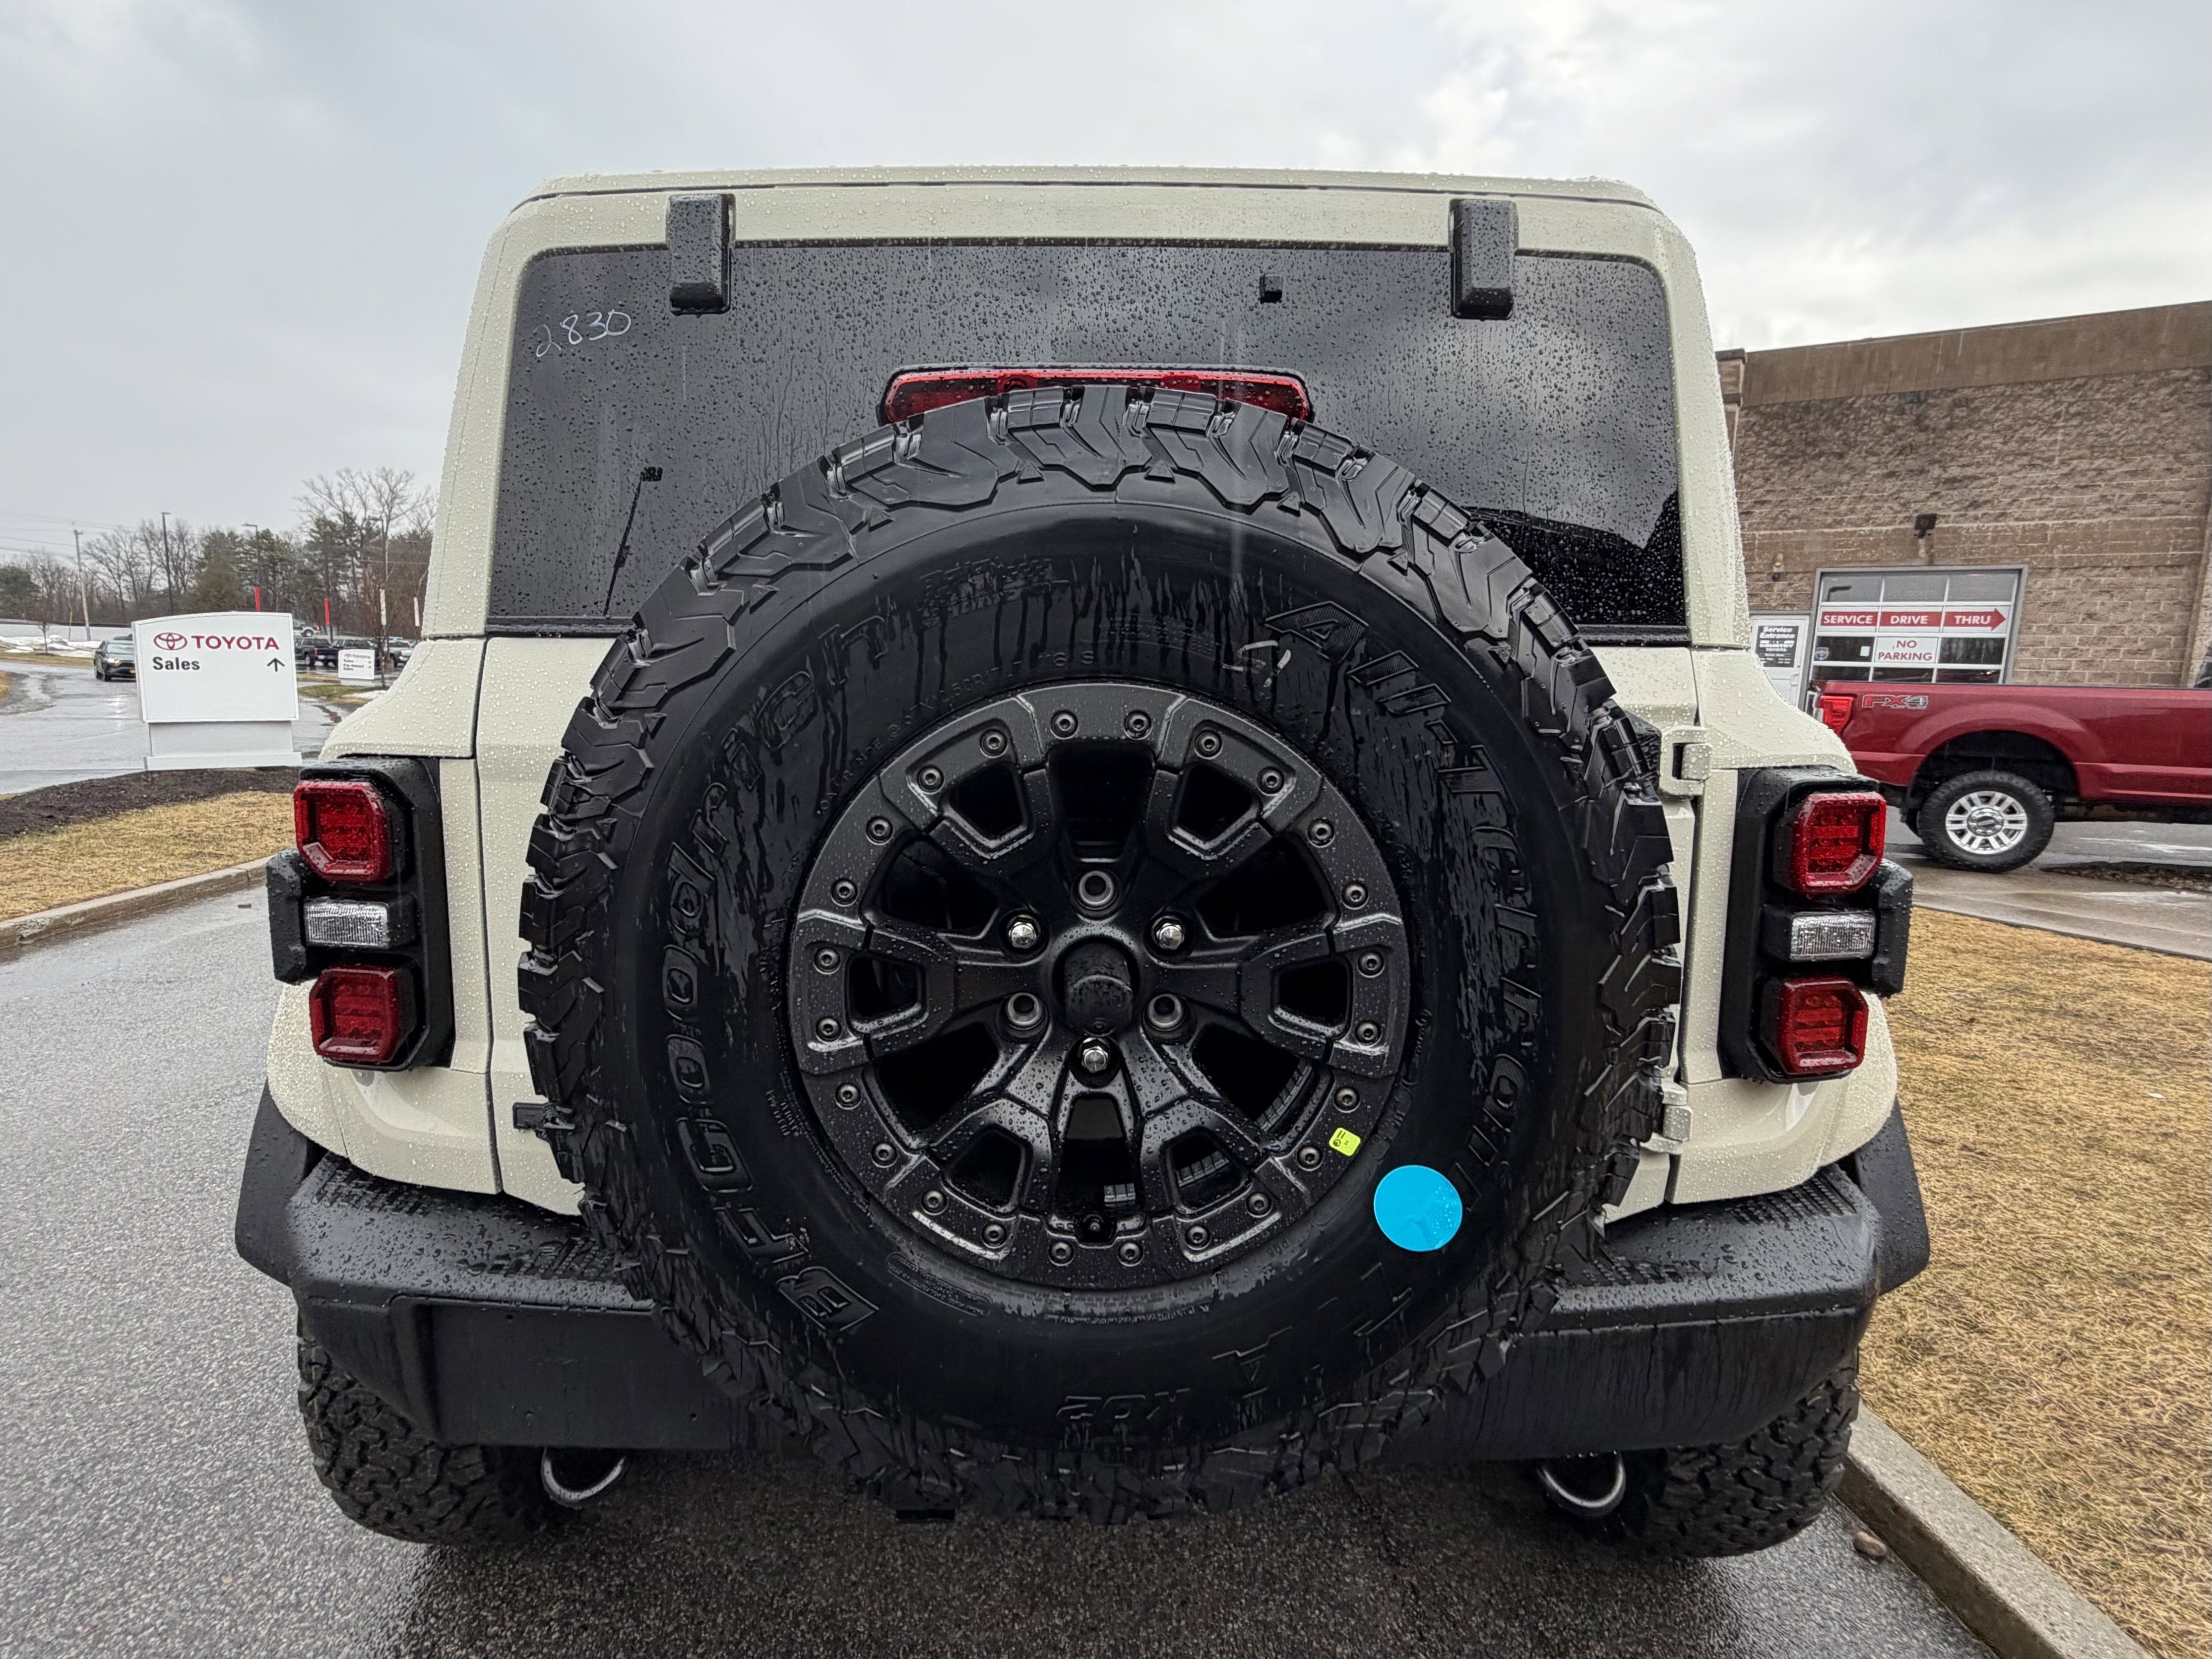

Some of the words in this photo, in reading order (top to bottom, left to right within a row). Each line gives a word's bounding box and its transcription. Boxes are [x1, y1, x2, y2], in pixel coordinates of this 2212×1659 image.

[535, 309, 631, 357] 2830
[1823, 615, 1873, 624] SERVICE
[1890, 615, 1929, 625] DRIVE
[1954, 615, 1991, 625] THRU
[191, 635, 280, 650] TOYOTA
[1896, 640, 1917, 648] NO
[152, 656, 200, 670] Sales
[1878, 652, 1933, 660] PARKING
[1862, 694, 1929, 708] FX4
